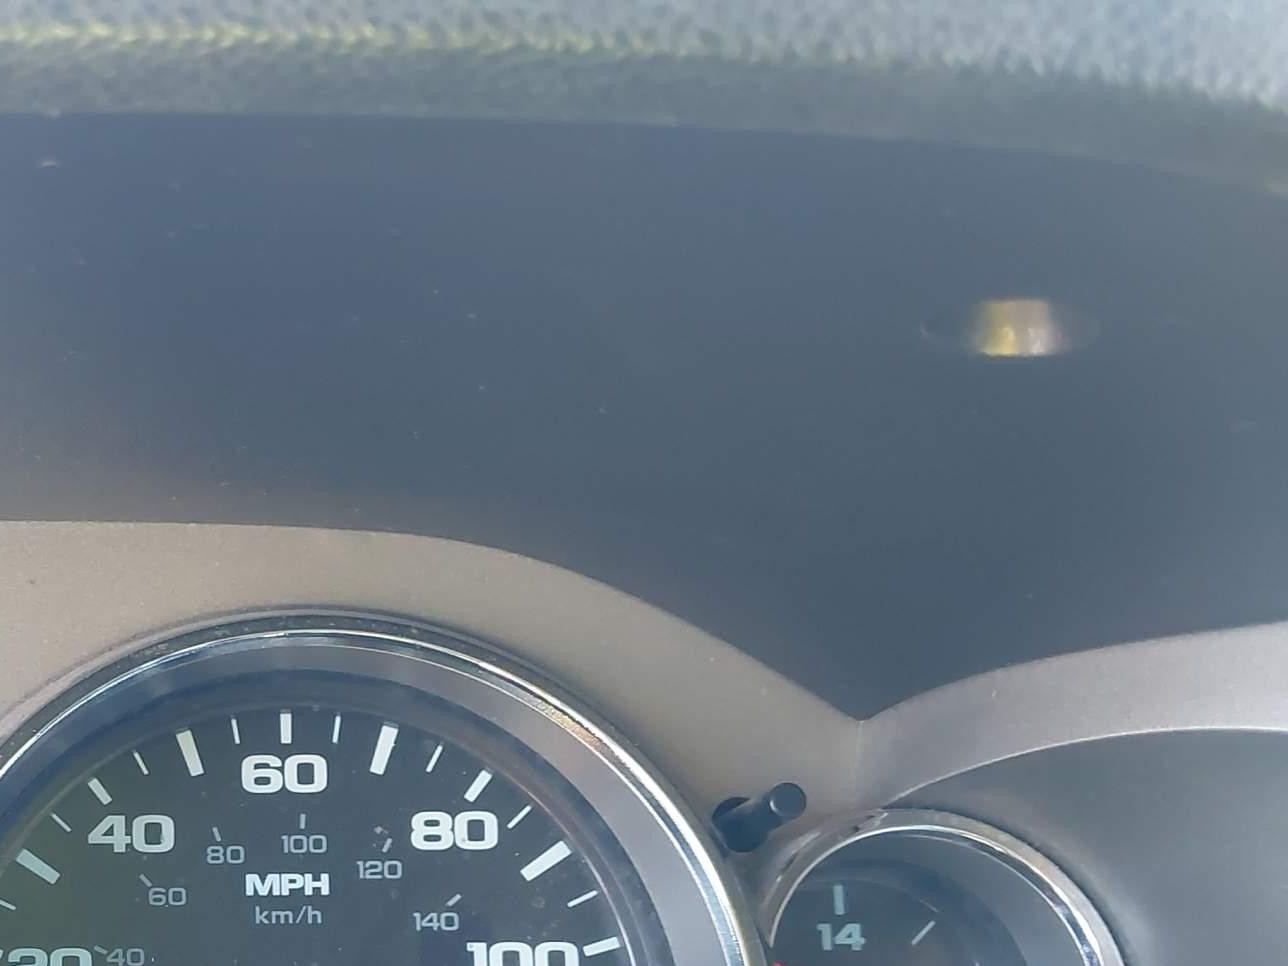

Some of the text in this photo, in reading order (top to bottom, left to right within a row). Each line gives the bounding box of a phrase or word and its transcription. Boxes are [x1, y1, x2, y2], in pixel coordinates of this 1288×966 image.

[241, 754, 327, 793] 60
[88, 815, 175, 852] 40
[411, 811, 498, 850] 80
[281, 835, 327, 853] 100
[206, 846, 245, 864] 80
[357, 861, 402, 879] 120
[245, 873, 330, 895] MPH
[148, 887, 186, 906] 60
[255, 906, 322, 924] km/h
[413, 912, 459, 931] 140
[816, 923, 866, 950] 14
[106, 948, 145, 966] 40
